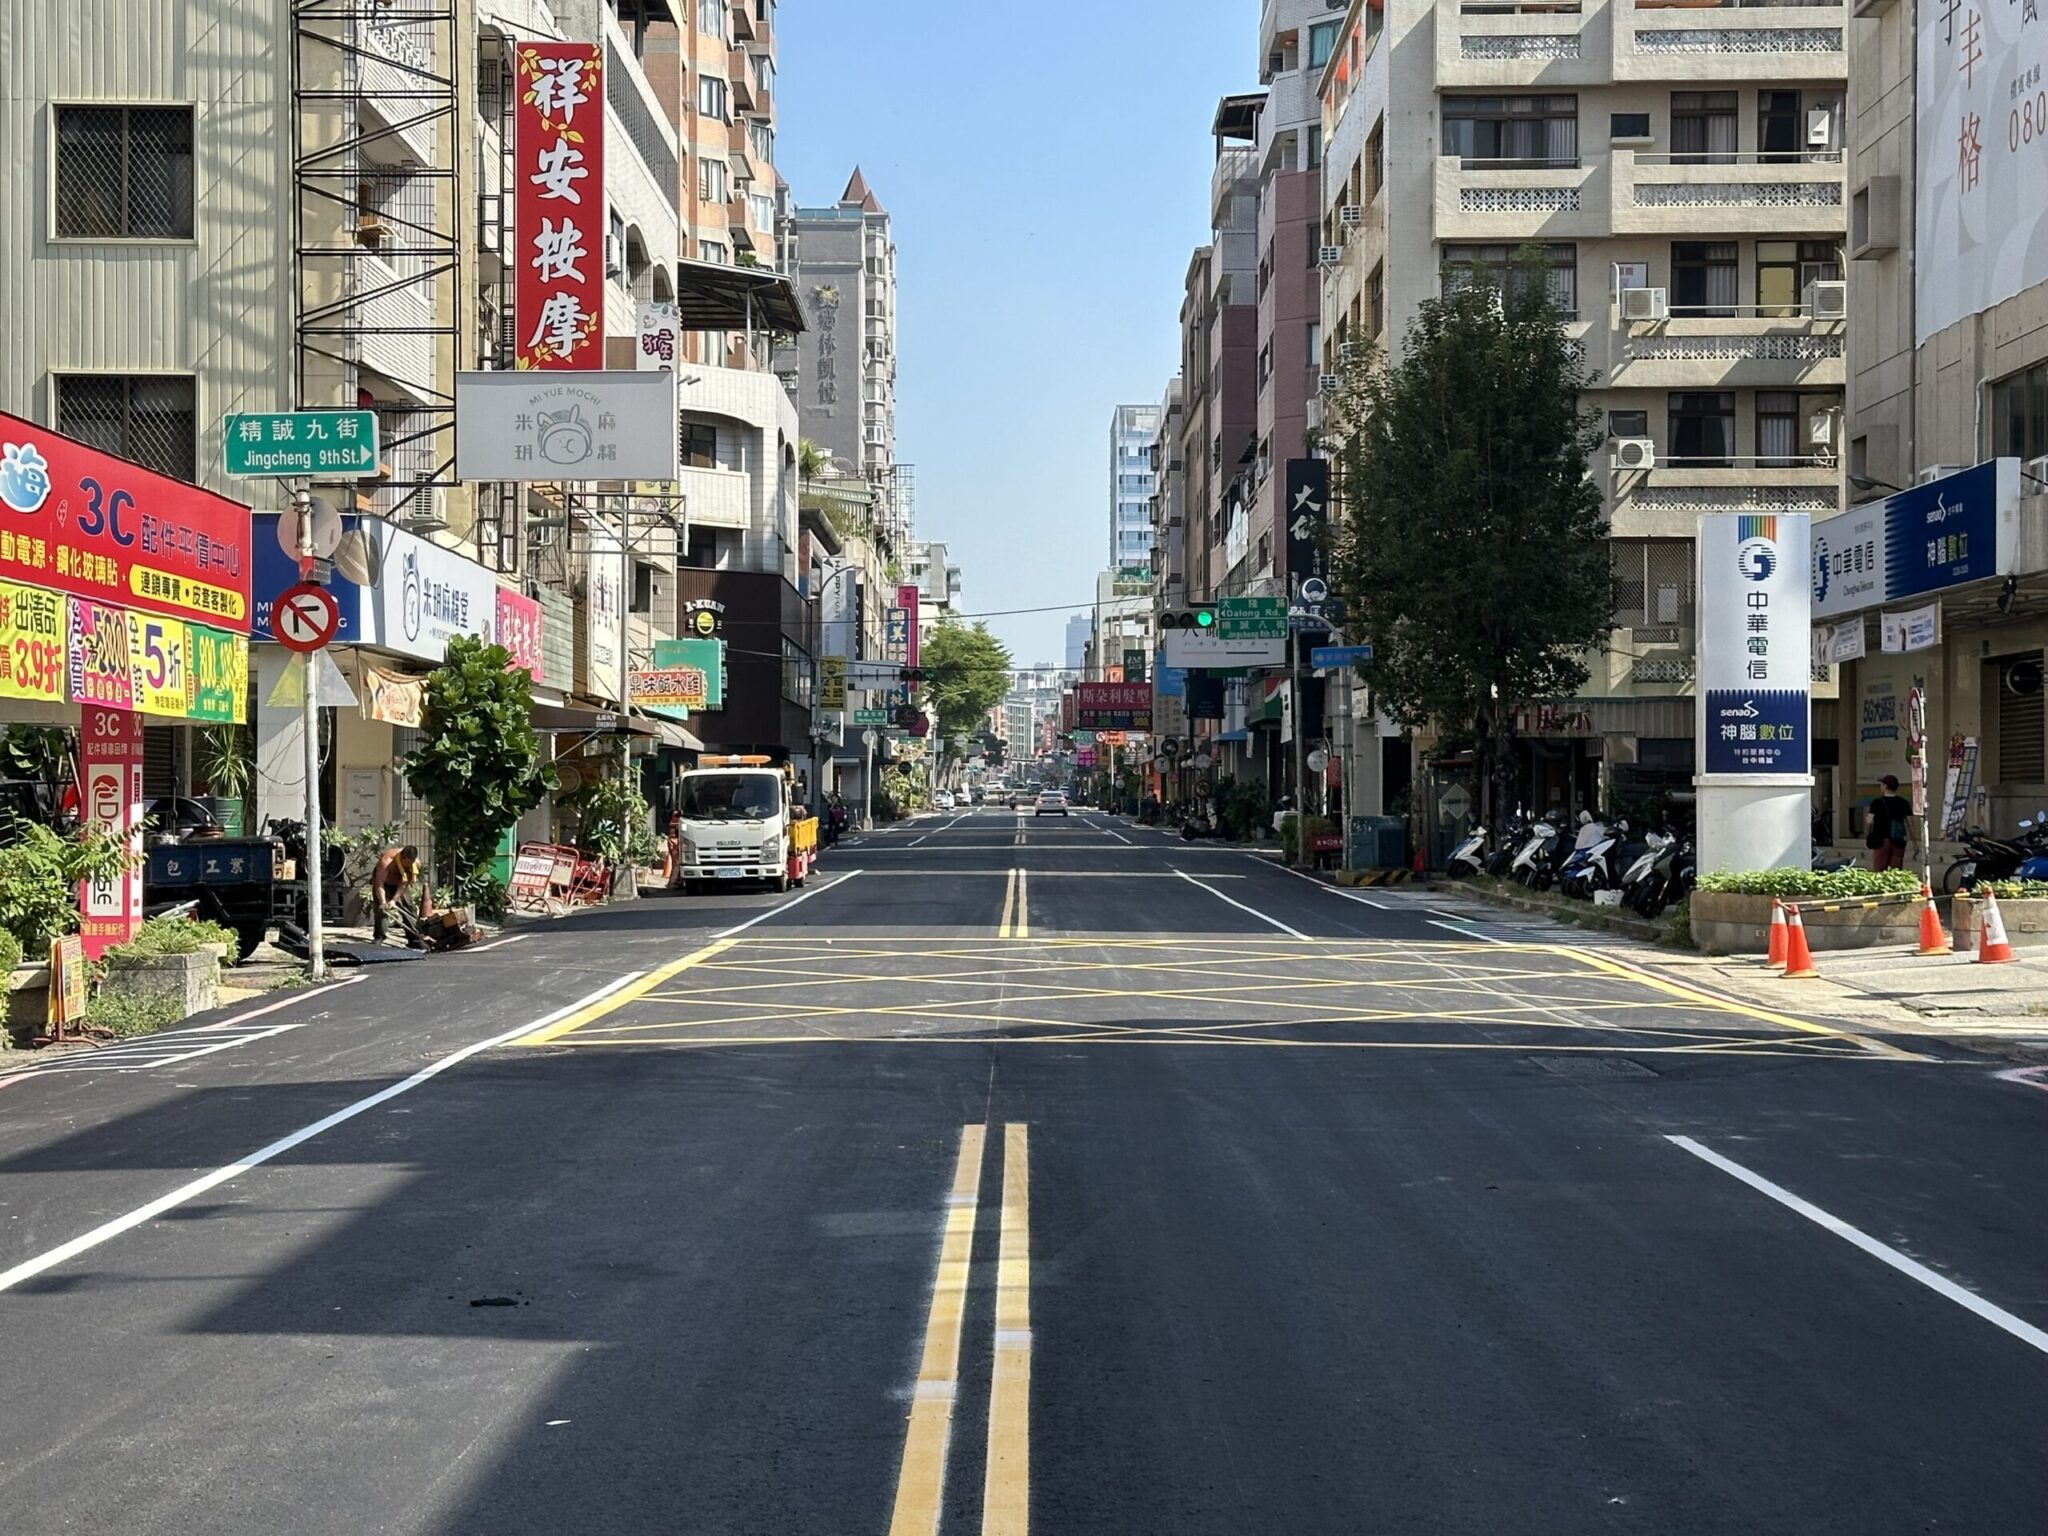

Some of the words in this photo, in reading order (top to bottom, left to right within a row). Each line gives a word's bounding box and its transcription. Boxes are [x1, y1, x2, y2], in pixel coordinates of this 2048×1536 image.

[527, 58, 591, 358] 祥安按摩
[529, 394, 542, 406] MI
[543, 387, 563, 398] YUE
[567, 387, 602, 406] MOCHI
[239, 419, 359, 442] 精誠九街
[244, 449, 312, 468] Jingcheng
[1833, 541, 1874, 580] 中華電信
[1226, 609, 1260, 618] Dalong
[1747, 591, 1768, 679] 中華電信
[15, 639, 62, 696] 3.9折
[94, 712, 120, 736] 3C
[1720, 724, 1794, 741] 神腦數位
